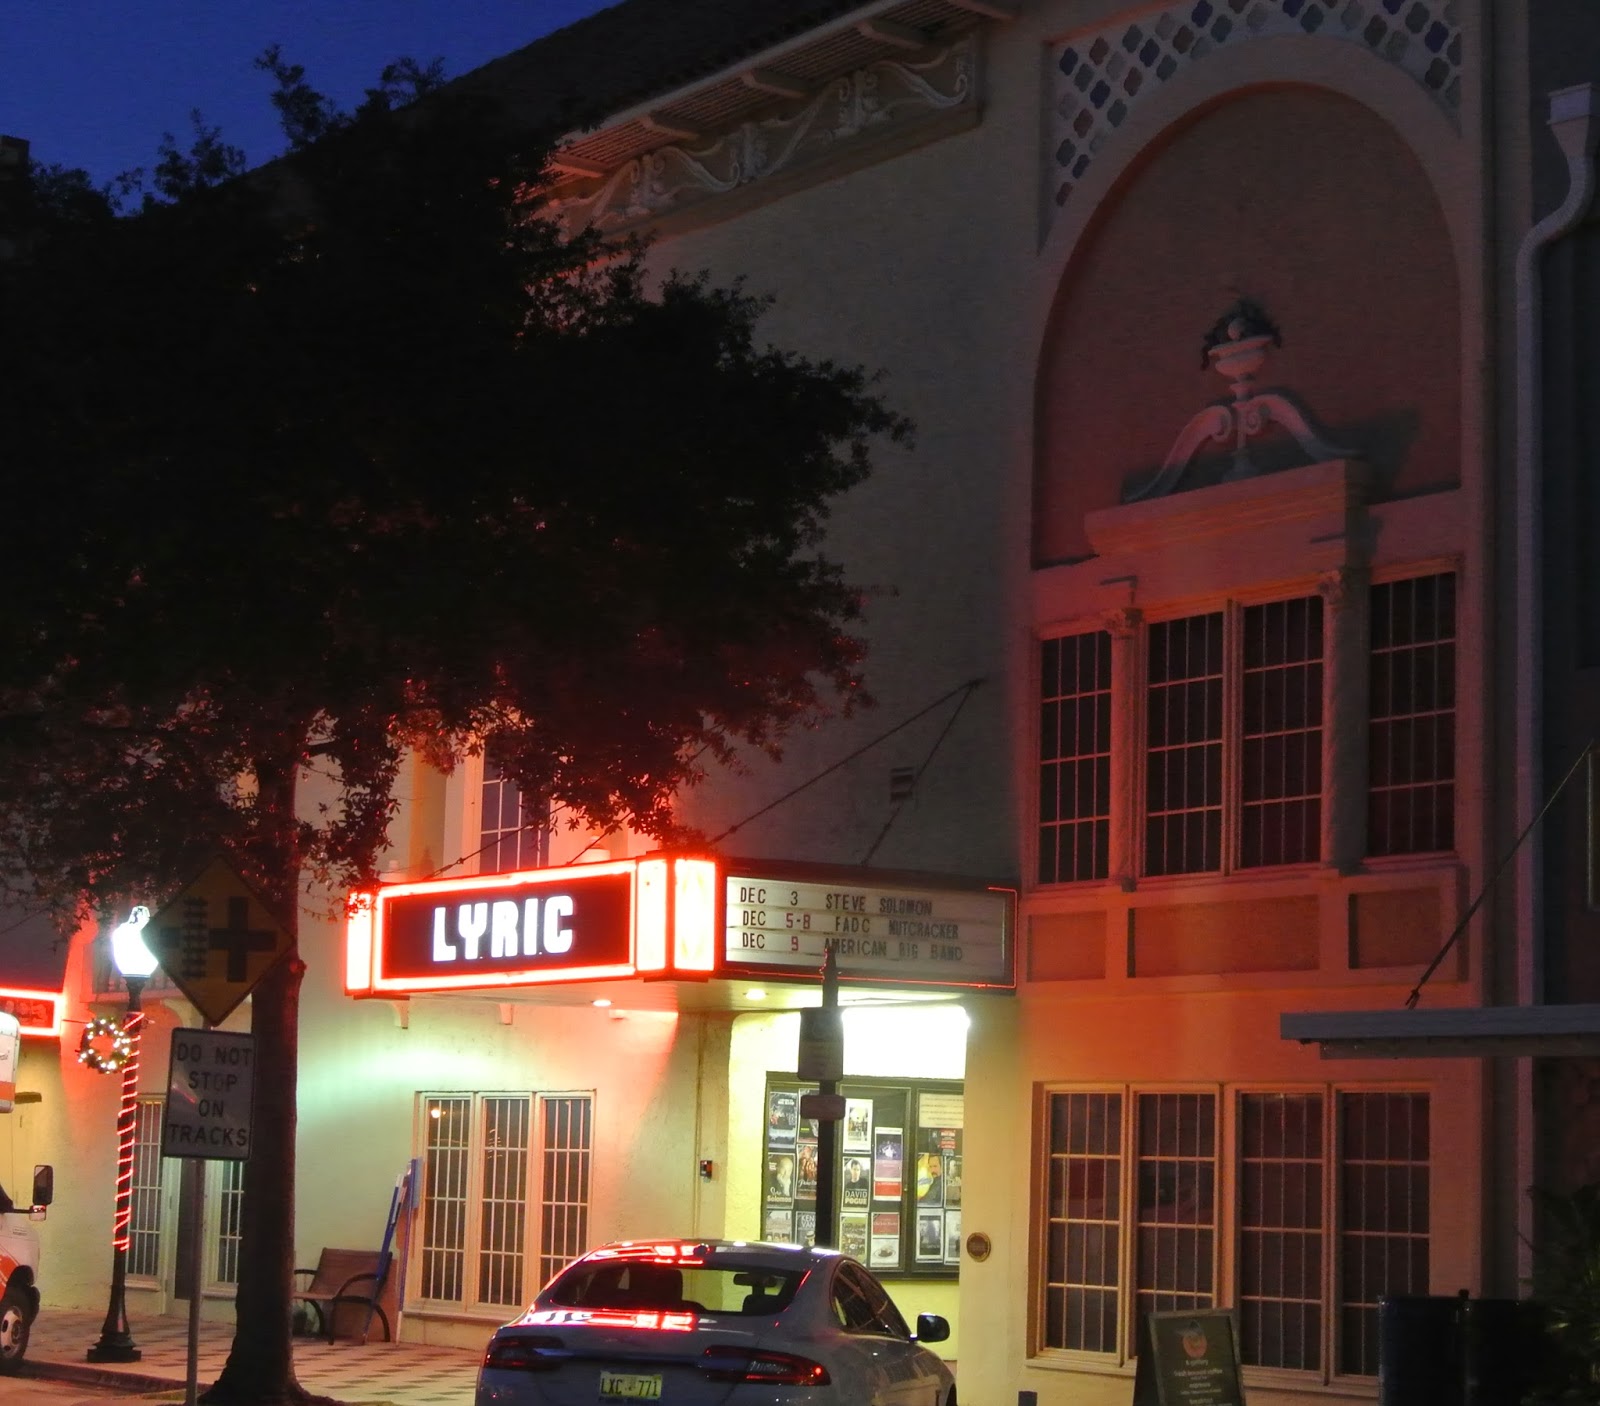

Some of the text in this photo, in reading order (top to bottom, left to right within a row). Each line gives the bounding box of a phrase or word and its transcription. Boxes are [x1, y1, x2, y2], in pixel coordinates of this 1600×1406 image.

[740, 887, 932, 916] DEC 3 STEVE SOLOMON
[433, 896, 574, 961] LYRIC
[743, 910, 959, 940] DEC 5-8 FADC NUTCRACKER
[742, 932, 765, 949] DEC
[791, 936, 799, 951] 9
[899, 942, 918, 959] BIG
[931, 944, 963, 961] BAND
[177, 1043, 252, 1066] DO NOT
[188, 1071, 237, 1092] STOP
[199, 1099, 223, 1118] ON
[169, 1123, 247, 1146] TRACKS
[844, 1197, 867, 1205] POGUE
[845, 1190, 868, 1198] DAVID
[638, 1380, 658, 1397] 771
